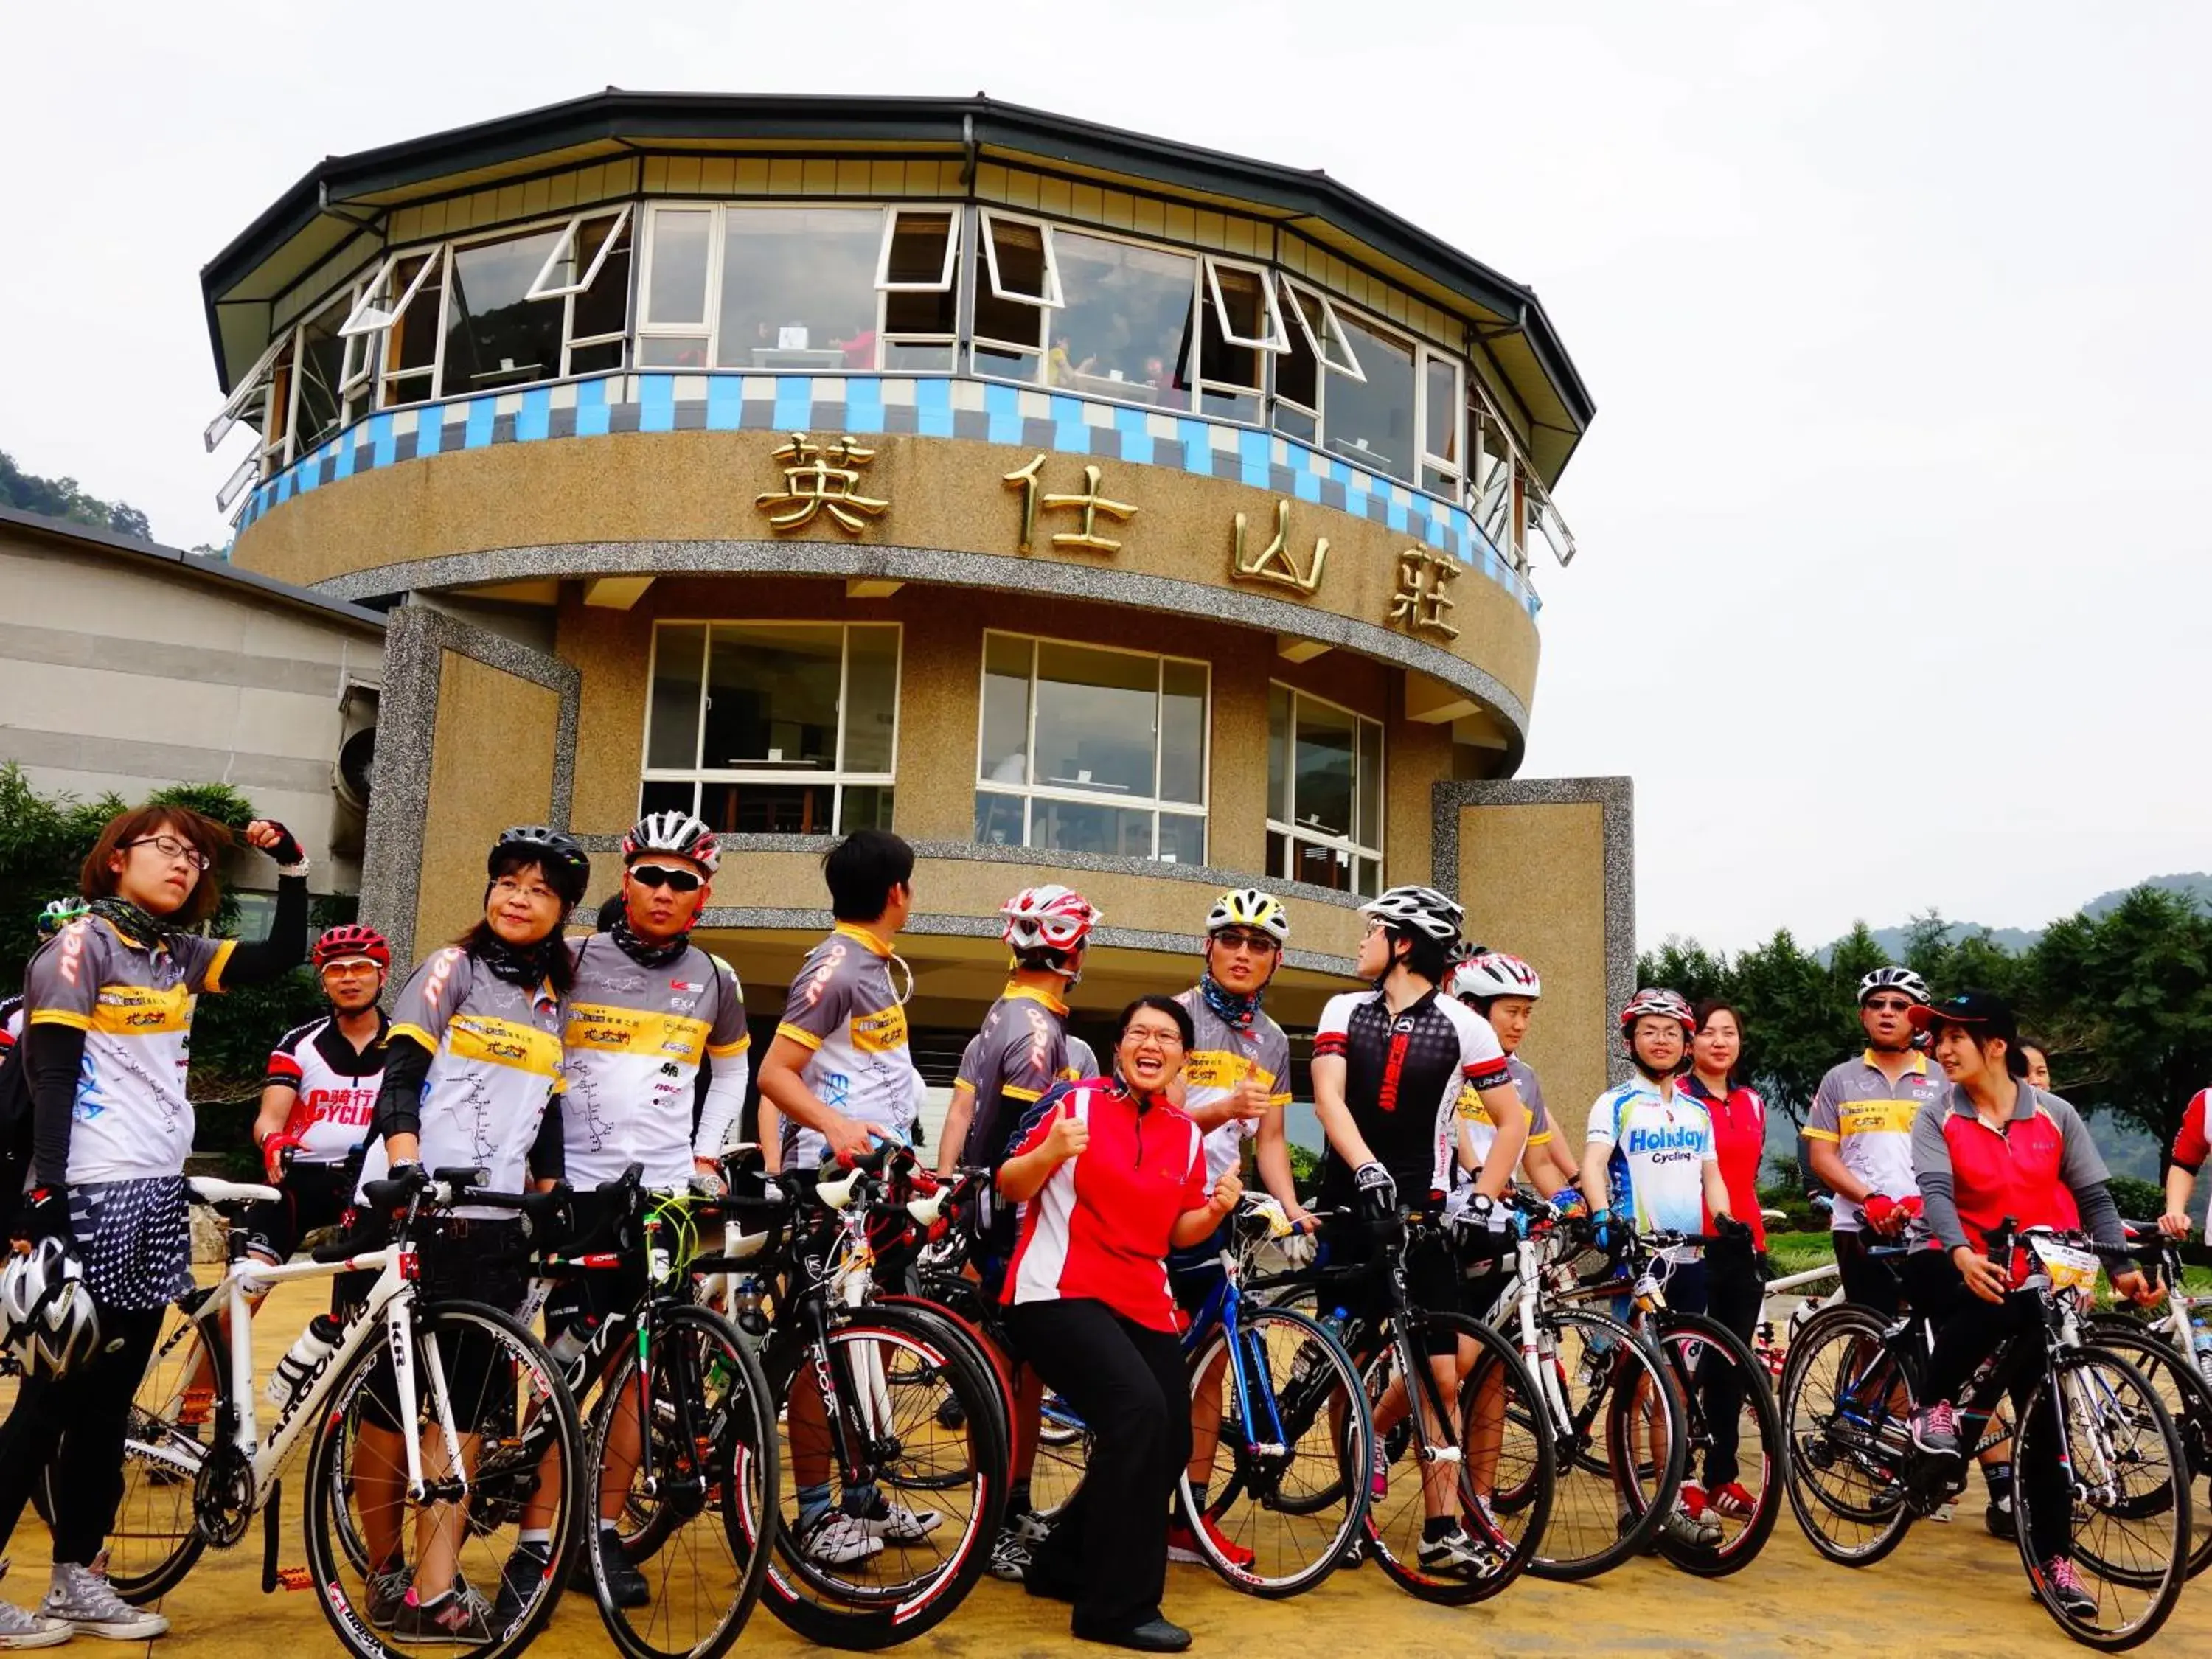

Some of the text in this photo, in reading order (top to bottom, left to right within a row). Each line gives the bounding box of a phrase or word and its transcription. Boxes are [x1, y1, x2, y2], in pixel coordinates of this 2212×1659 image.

[755, 431, 1462, 641] 英仕山莊
[1628, 1126, 1703, 1152] Holiday
[1652, 1152, 1691, 1164] Cycling
[812, 1345, 834, 1416] KUOTA
[125, 1445, 197, 1476] KRYPTON
